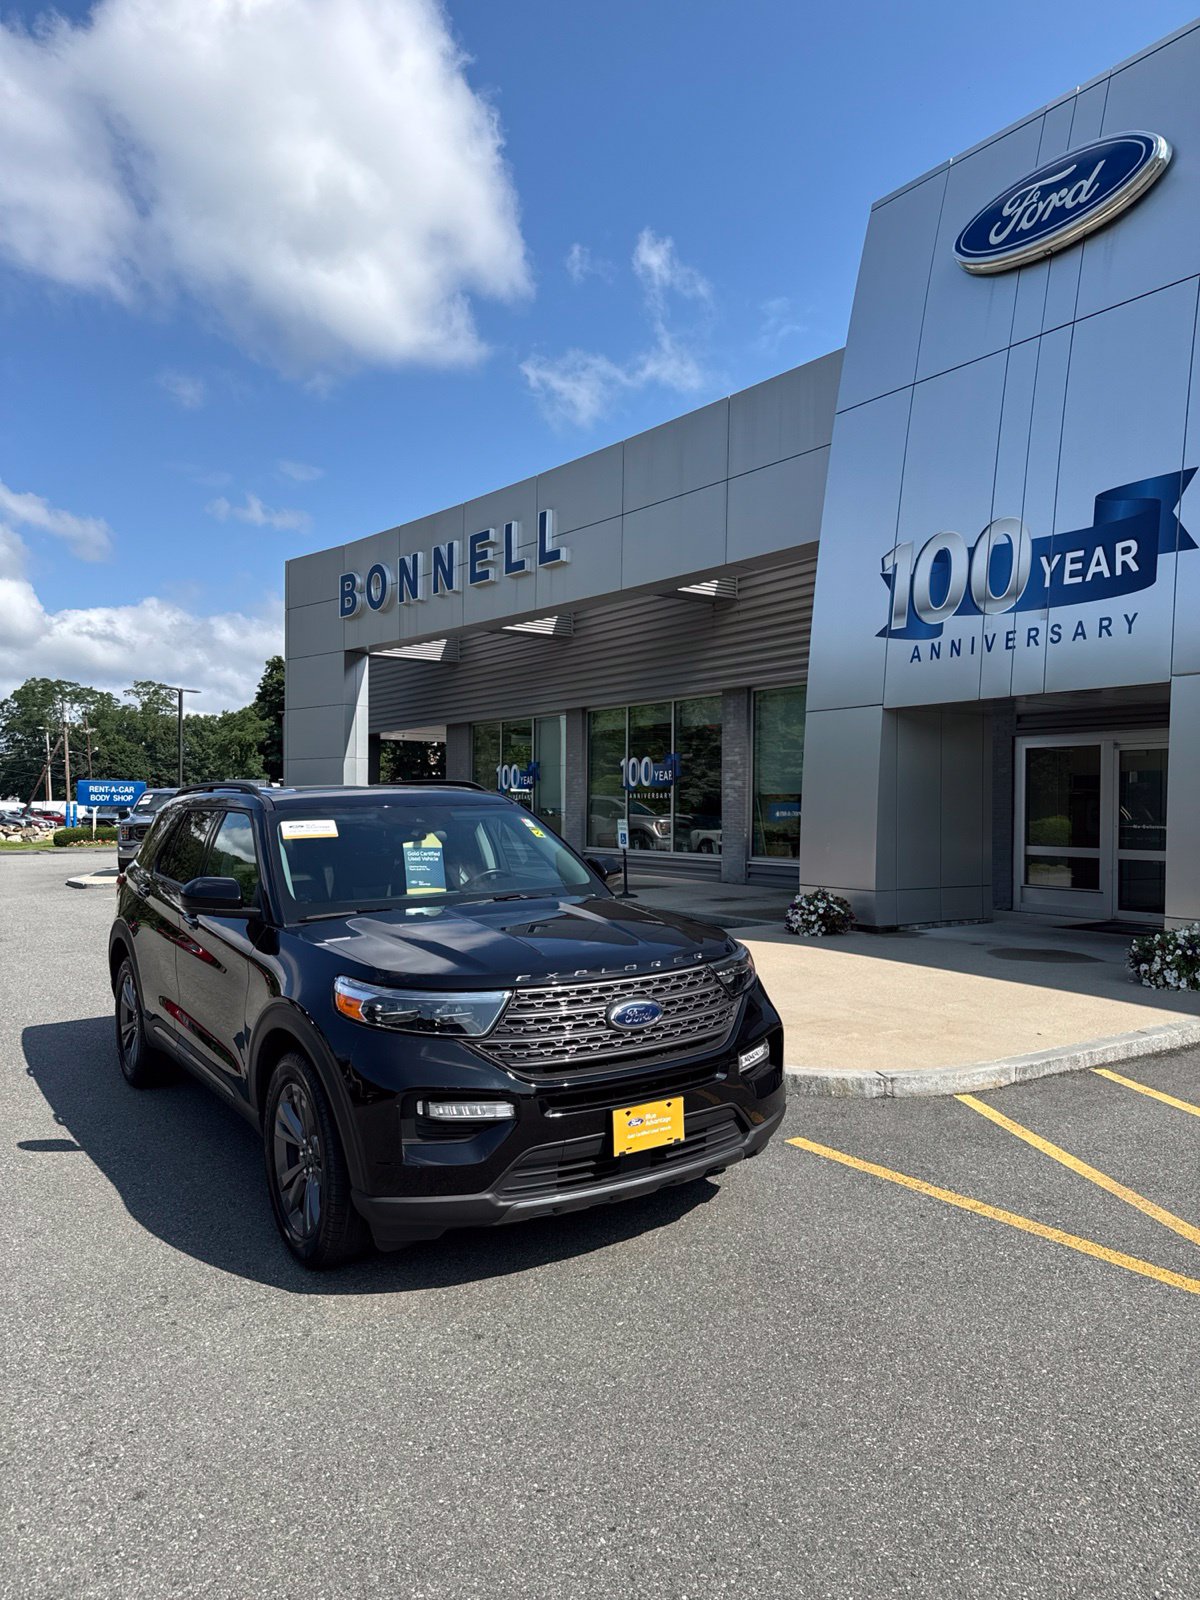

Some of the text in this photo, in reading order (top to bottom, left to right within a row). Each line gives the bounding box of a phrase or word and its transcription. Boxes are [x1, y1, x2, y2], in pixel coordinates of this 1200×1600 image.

[989, 159, 1106, 246] Ford
[339, 509, 566, 619] BONNELL
[881, 516, 1140, 630] 100 YEAR
[910, 612, 1139, 664] ANNIVERSARY
[496, 764, 520, 789] 100
[620, 756, 672, 787] 100 YEAR
[88, 785, 135, 793] RENT-A-CAR
[90, 794, 133, 802] BODY SHOP
[516, 952, 703, 982] EXPLORER
[625, 1007, 652, 1024] Ford
